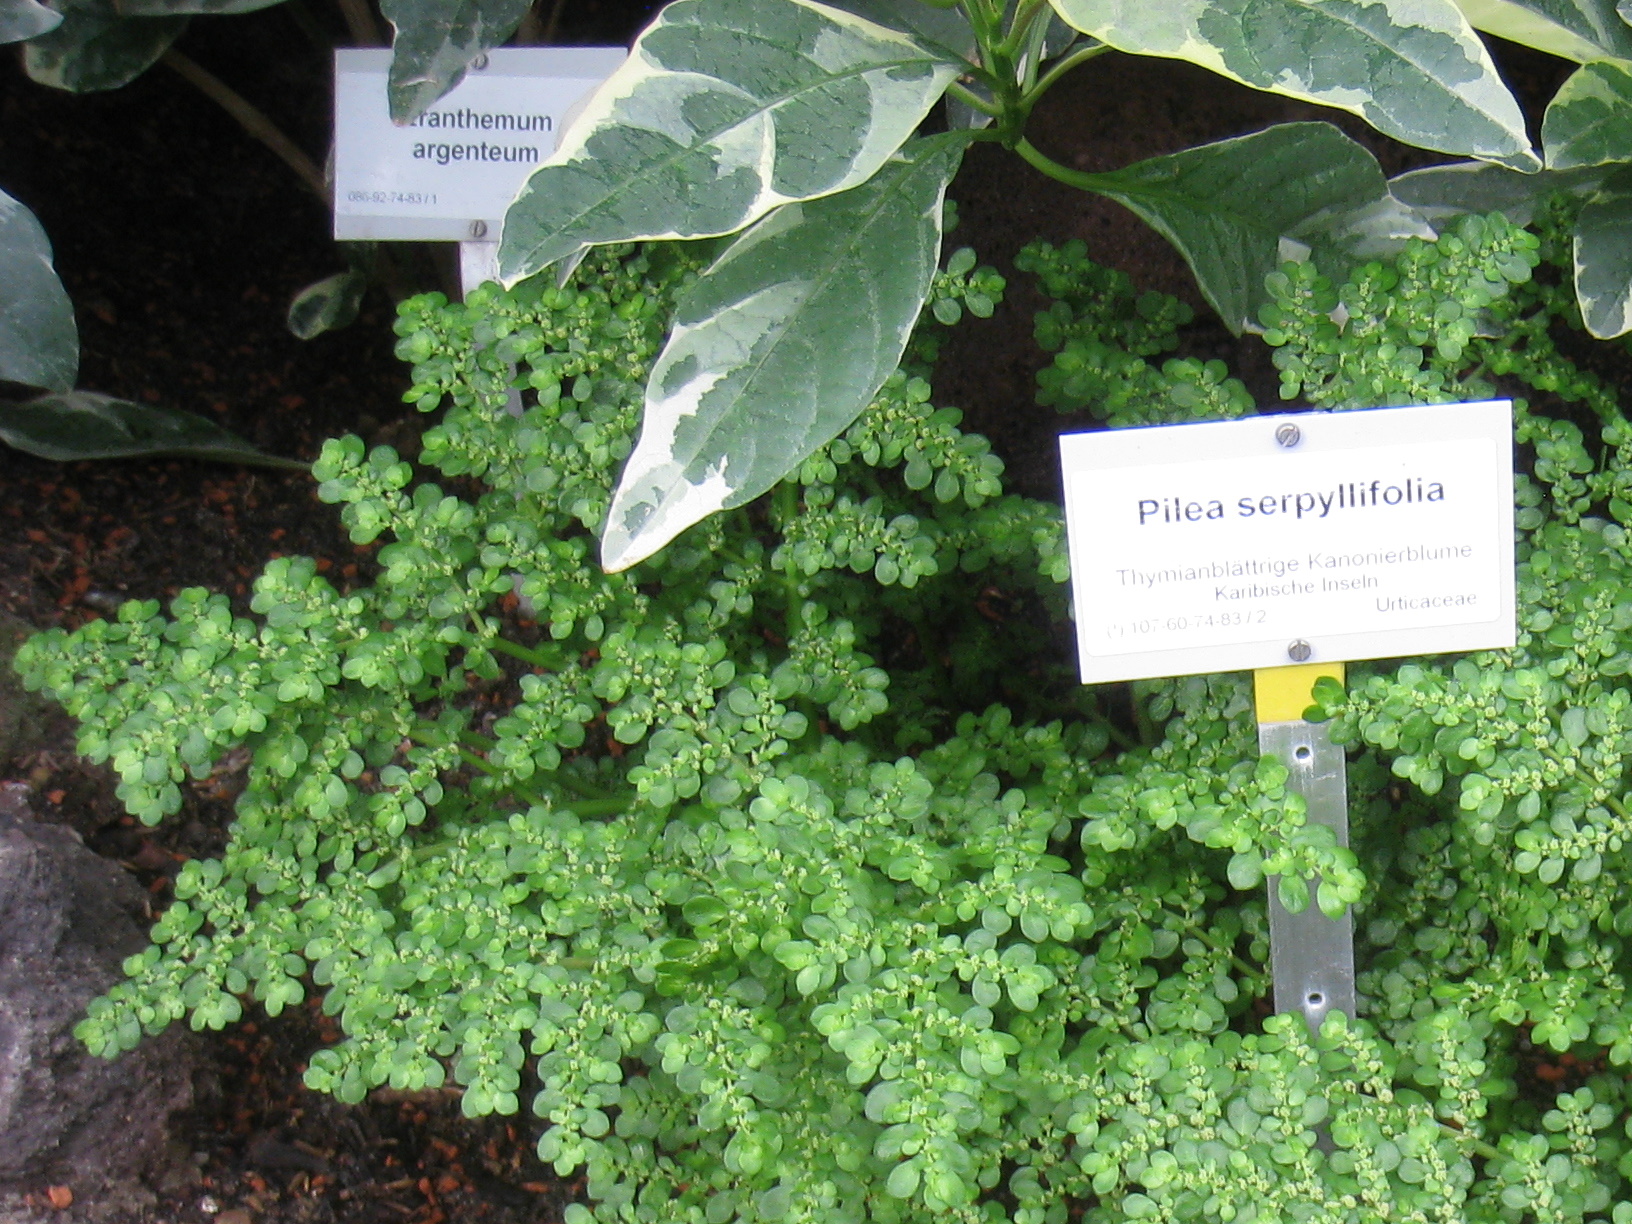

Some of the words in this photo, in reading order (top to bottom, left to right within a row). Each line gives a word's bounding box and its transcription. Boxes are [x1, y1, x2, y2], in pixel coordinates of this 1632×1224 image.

[410, 108, 552, 131] ranthemum
[413, 141, 539, 165] argenteum
[1138, 496, 1225, 525] Pilea
[1237, 477, 1446, 520] serpyllifolia
[1115, 556, 1300, 589] Thymianblättrige
[1308, 543, 1473, 571] Kanonierblume
[1214, 579, 1315, 602] Karibische
[1321, 574, 1379, 593] Inseln
[1375, 590, 1478, 613] Urticaceae
[1131, 611, 1242, 635] 107-60-74-83
[1256, 609, 1267, 624] 2
